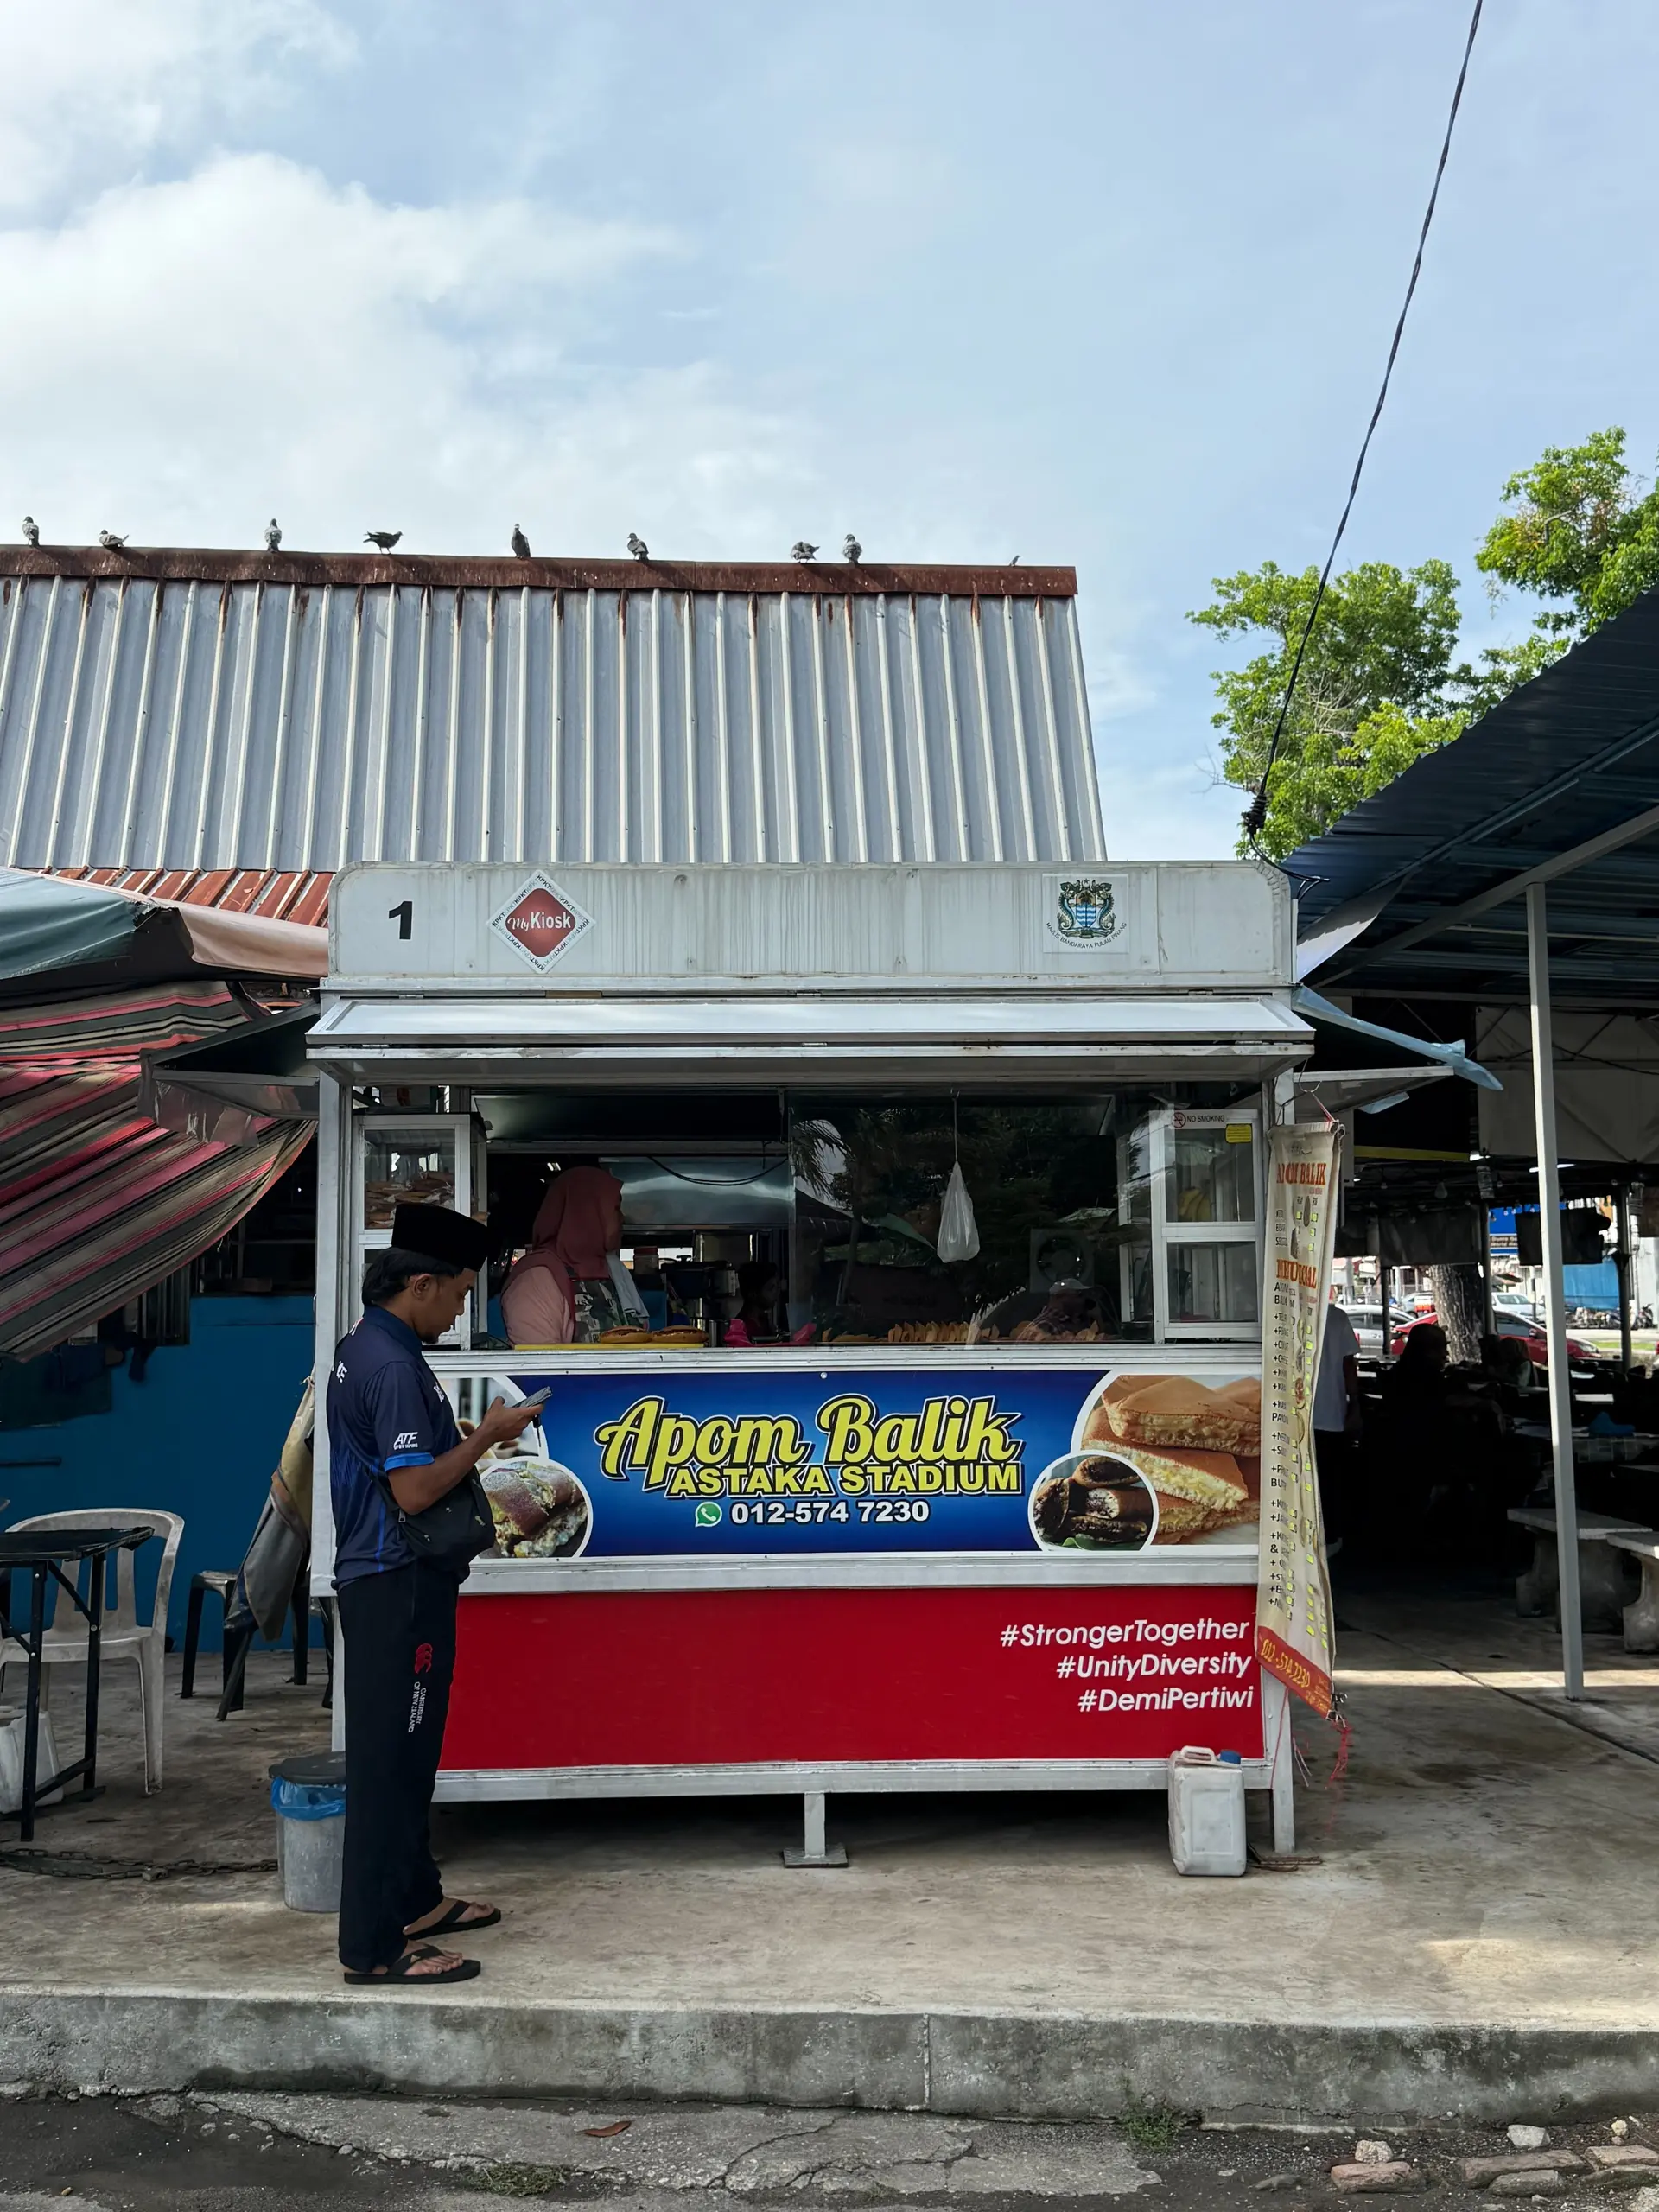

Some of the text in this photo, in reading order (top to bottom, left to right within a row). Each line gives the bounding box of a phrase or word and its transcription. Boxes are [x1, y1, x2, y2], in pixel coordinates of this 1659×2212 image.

[389, 900, 414, 940] 1
[1046, 922, 1127, 949] MAJLIS BANDARAYA PULAU PINANG
[393, 1432, 418, 1447] ATF
[594, 1394, 1023, 1488] Apom Balik
[666, 1465, 1022, 1497] ASTAKA STADIUM
[732, 1500, 930, 1524] 012-574 7230
[1001, 1618, 1249, 1649] #StrongerTogether
[1057, 1652, 1252, 1681] #UnityDiversity
[1077, 1686, 1254, 1713] #DemiPertiwi
